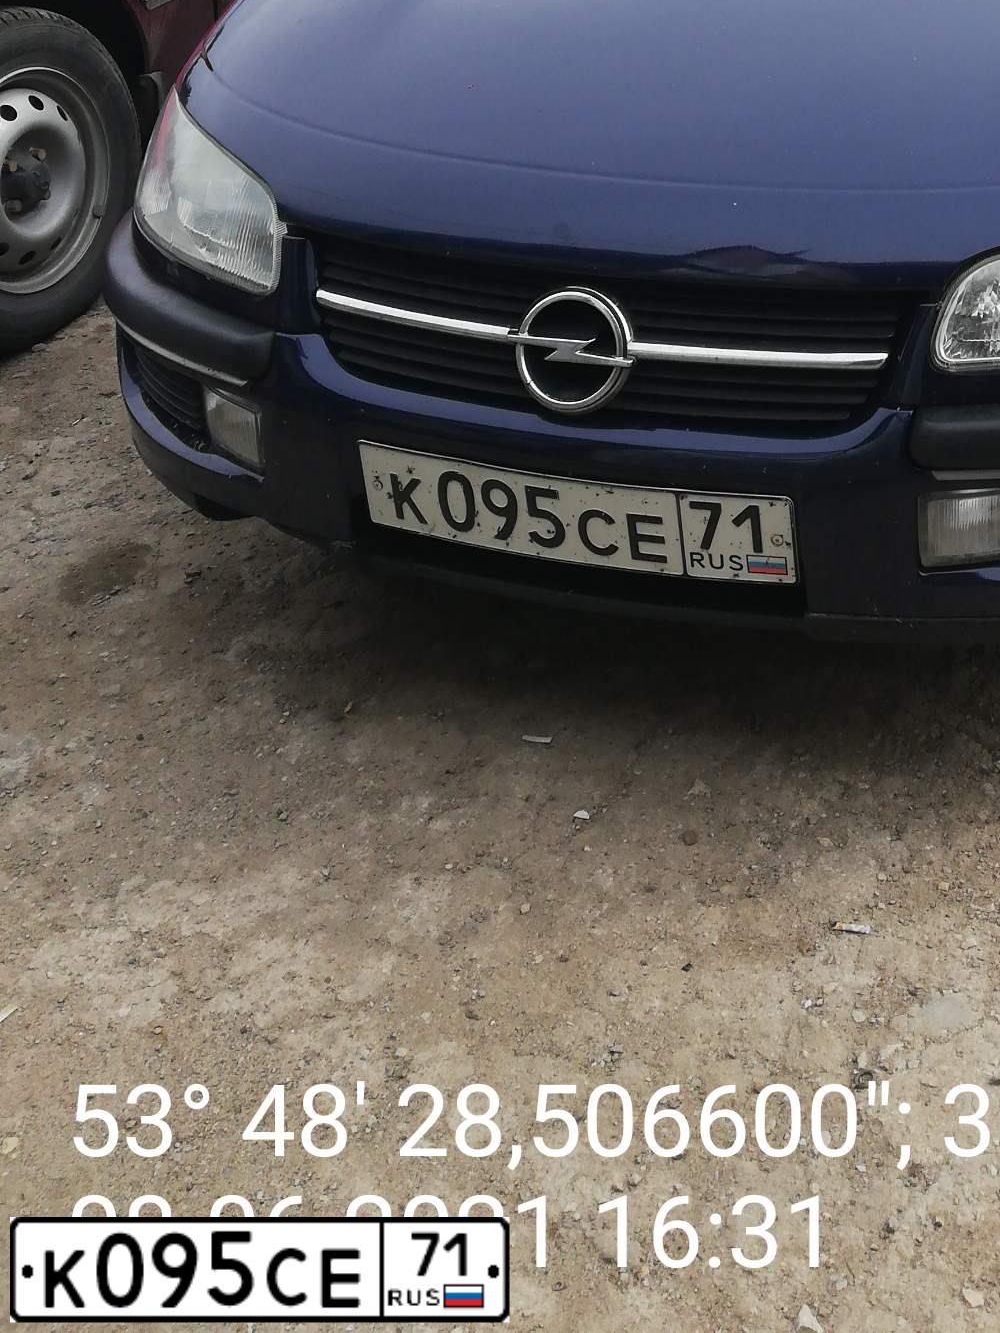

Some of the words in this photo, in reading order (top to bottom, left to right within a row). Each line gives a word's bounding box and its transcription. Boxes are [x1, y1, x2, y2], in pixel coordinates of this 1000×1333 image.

[389, 470, 668, 564] К095СЕ
[688, 500, 764, 554] 71
[689, 551, 744, 571] RUS
